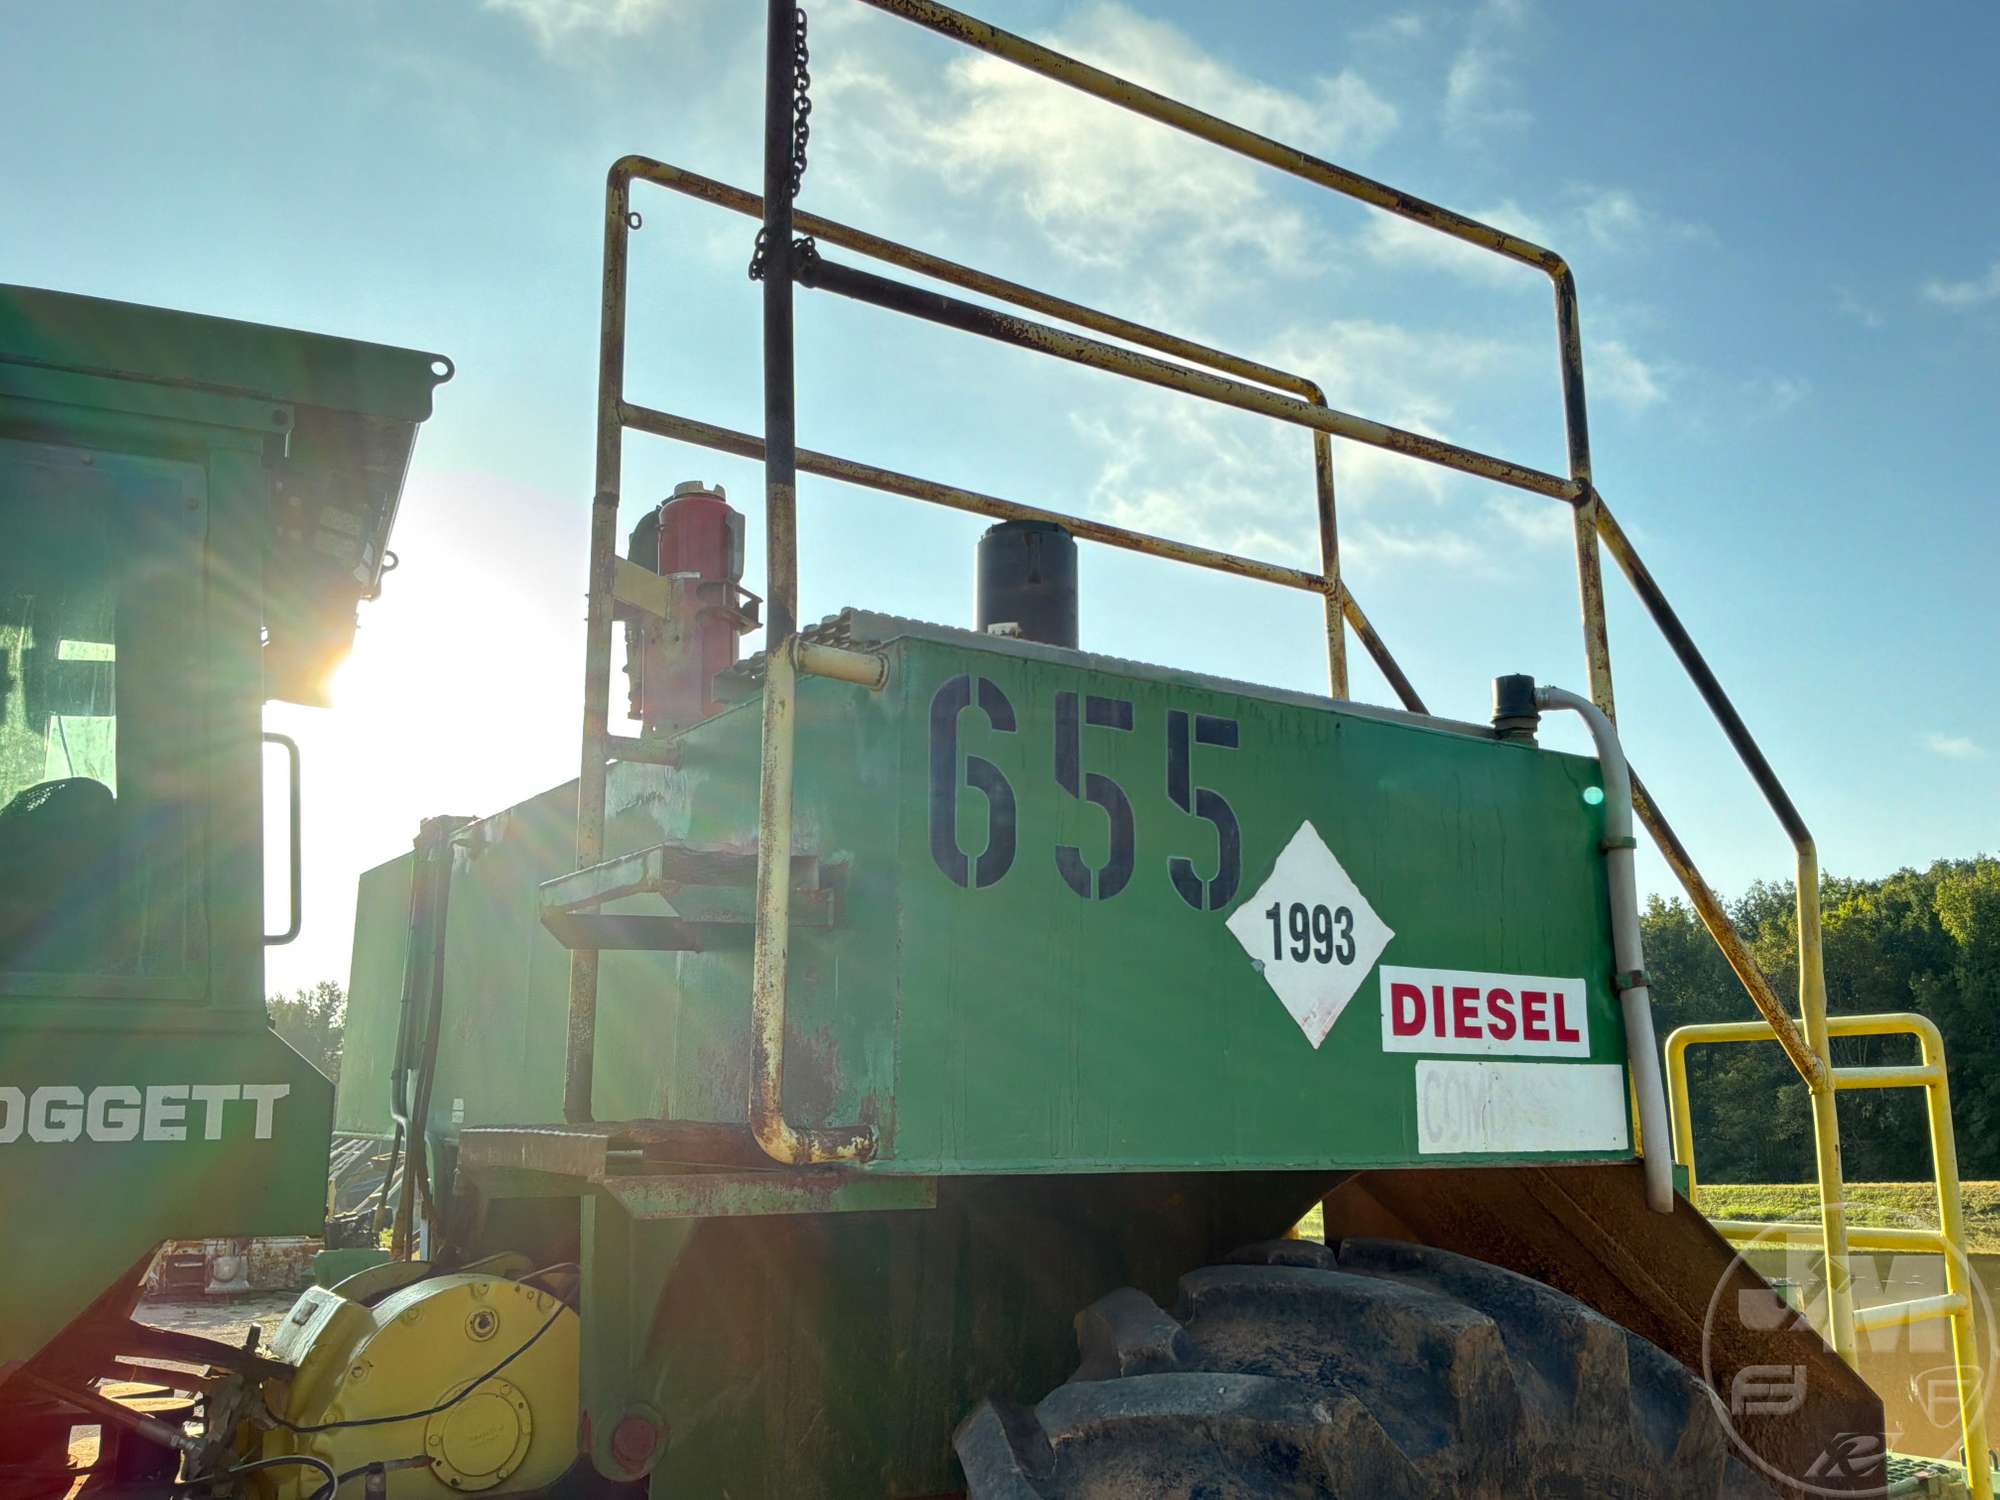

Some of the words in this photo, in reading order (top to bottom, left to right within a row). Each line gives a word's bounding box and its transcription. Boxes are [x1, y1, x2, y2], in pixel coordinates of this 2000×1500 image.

[929, 674, 1242, 912] 655
[1265, 902, 1356, 966] 1993
[1391, 983, 1580, 1043] DIESEL
